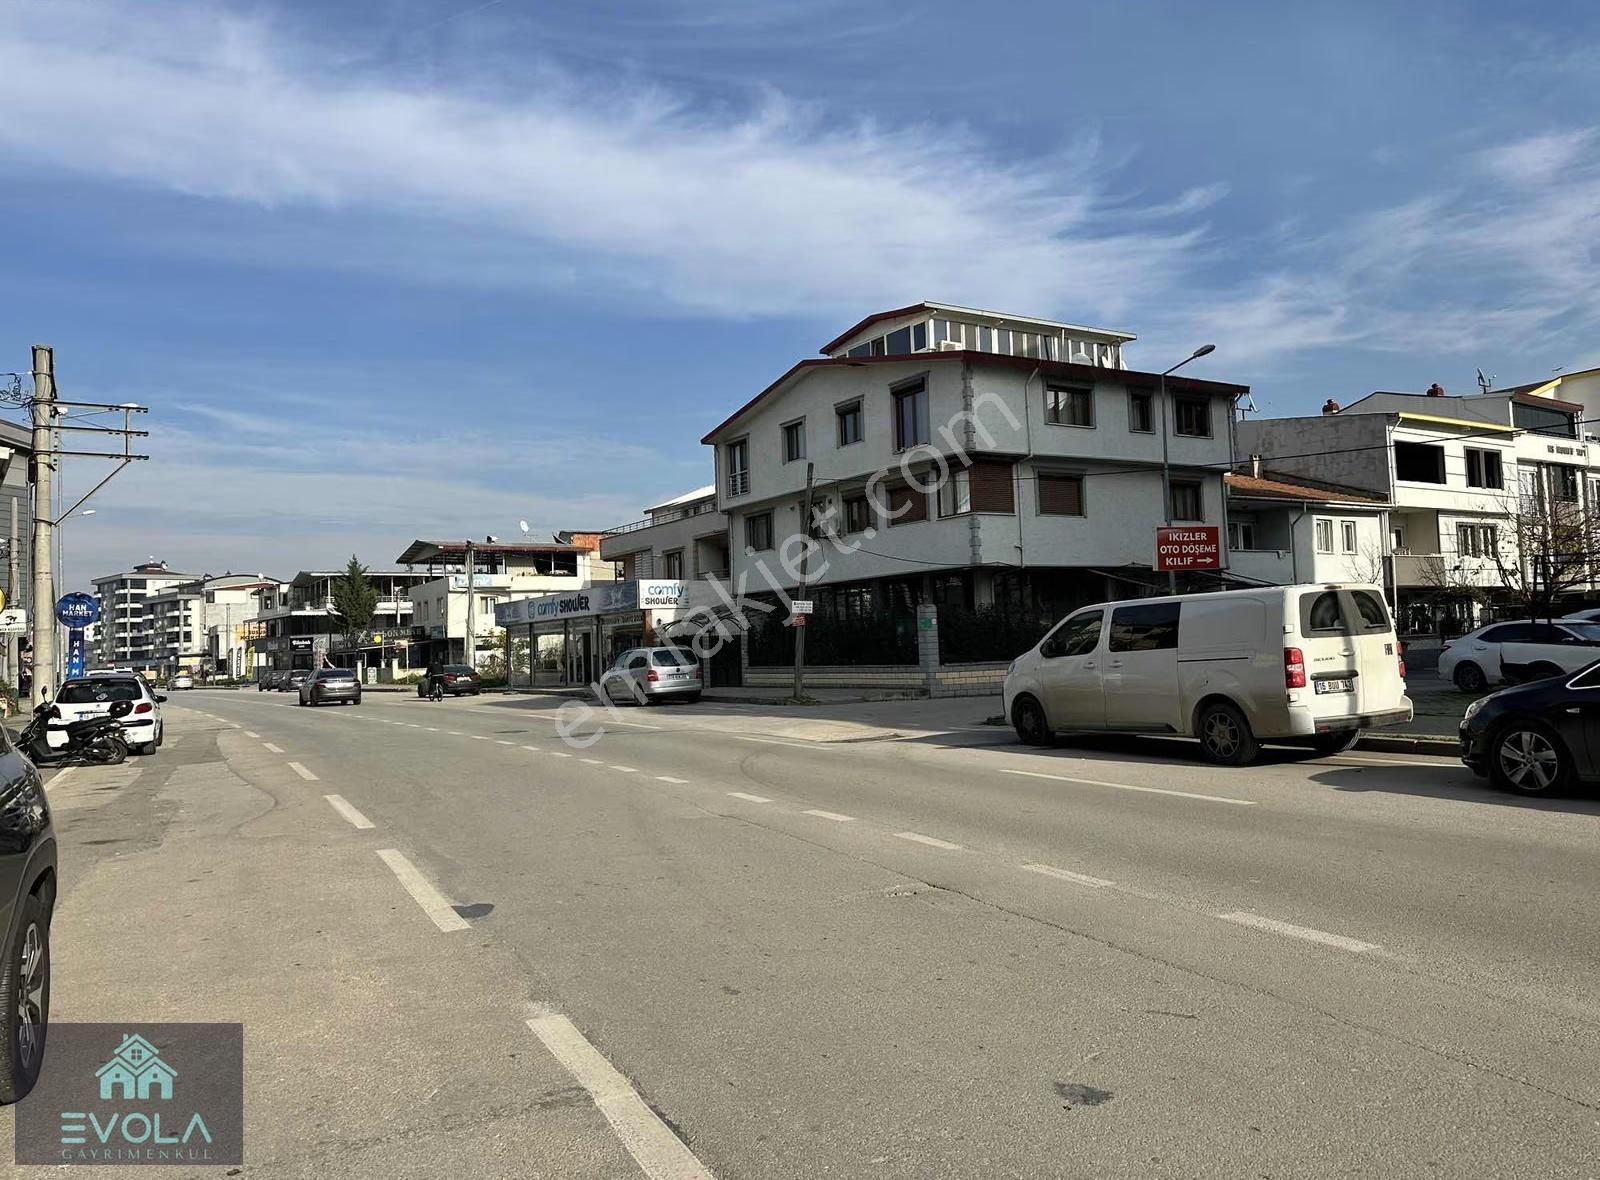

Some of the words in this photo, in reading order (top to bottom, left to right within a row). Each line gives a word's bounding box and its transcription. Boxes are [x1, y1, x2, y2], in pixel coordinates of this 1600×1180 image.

[1160, 545, 1180, 554] OTO
[1182, 543, 1217, 555] DÖŞEME
[1165, 557, 1194, 566] KILIF
[648, 582, 684, 597] comfy
[537, 597, 559, 616] comfy
[559, 593, 590, 613] SHOWER
[645, 596, 679, 605] SHOWER
